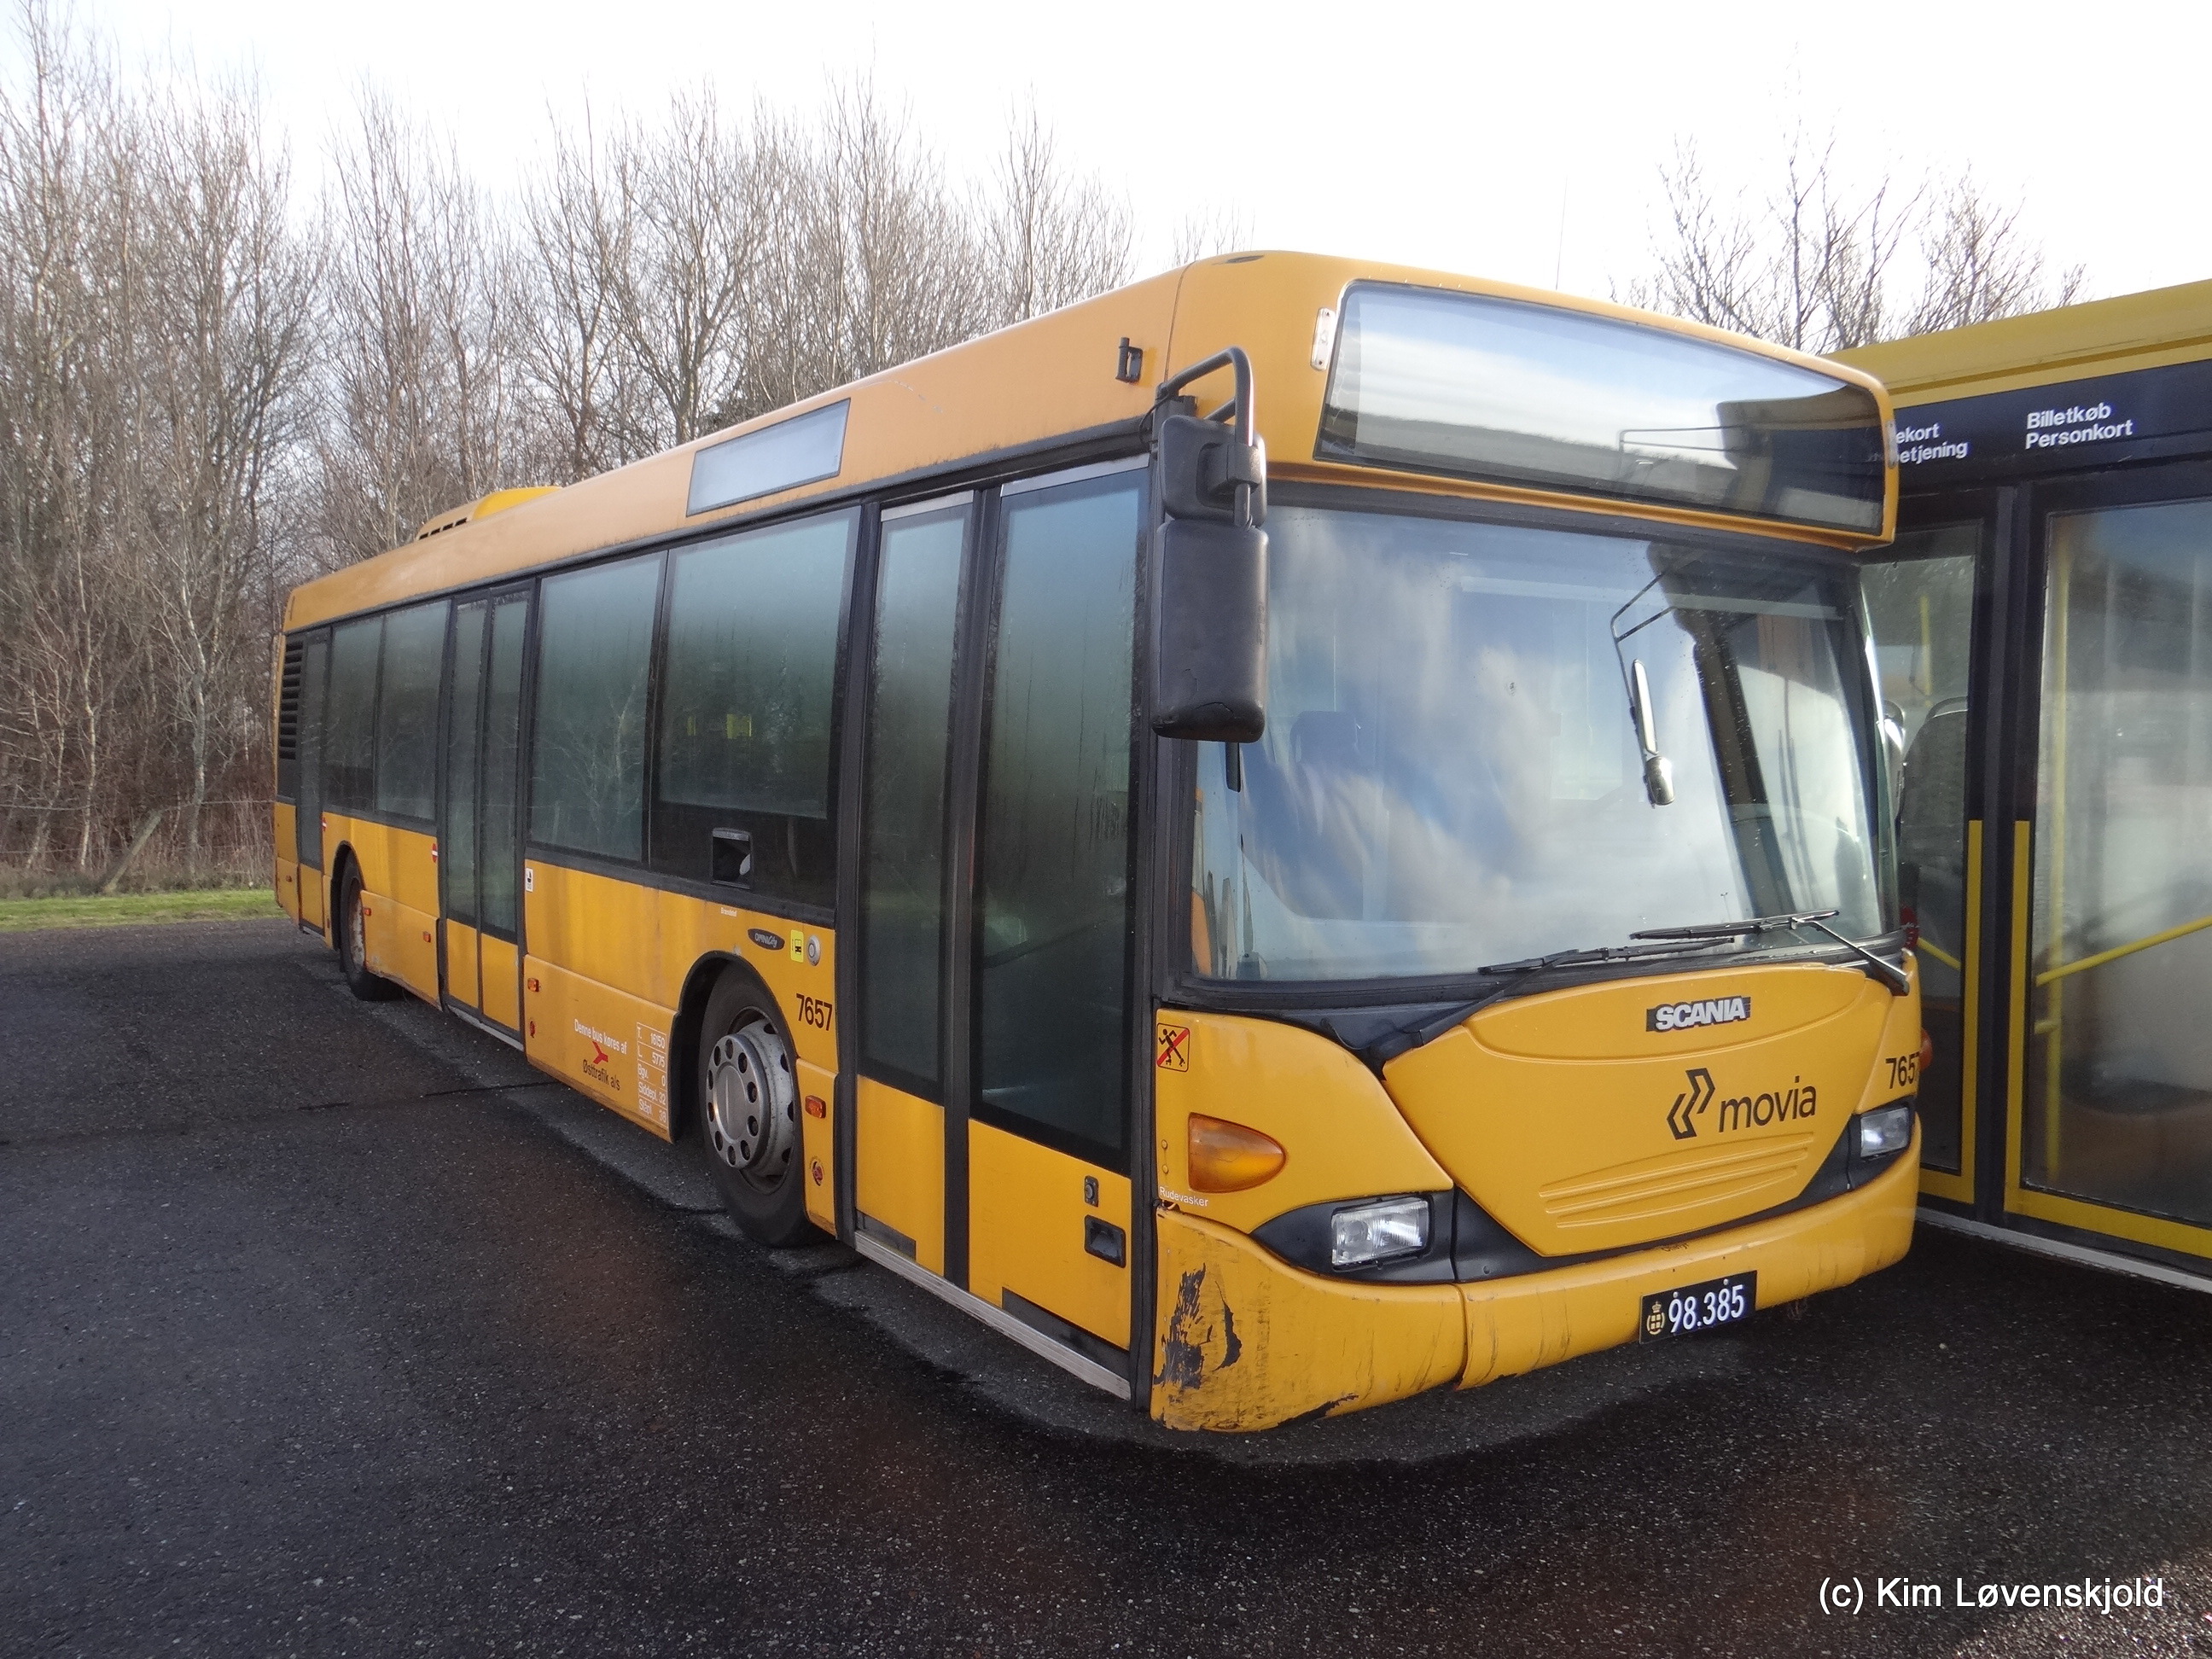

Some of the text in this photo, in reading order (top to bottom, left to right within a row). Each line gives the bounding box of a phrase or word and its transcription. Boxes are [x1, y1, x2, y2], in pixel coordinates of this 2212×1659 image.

[2027, 402, 2111, 429] Billetkøb
[1895, 422, 1940, 444] ekort
[2025, 419, 2133, 450] Personkort
[1897, 441, 1968, 464] etjening
[795, 992, 833, 1032] 7657
[1655, 996, 1746, 1030] SCANIA
[573, 1018, 591, 1038] Denne
[592, 1027, 602, 1043] bus
[620, 1041, 627, 1055] af
[583, 1059, 609, 1086] Østtrafik
[652, 1051, 666, 1068] 5775
[1718, 1075, 1817, 1133] movia
[1159, 1186, 1209, 1207] Rudevasker
[1668, 1284, 1745, 1333] 98.385
